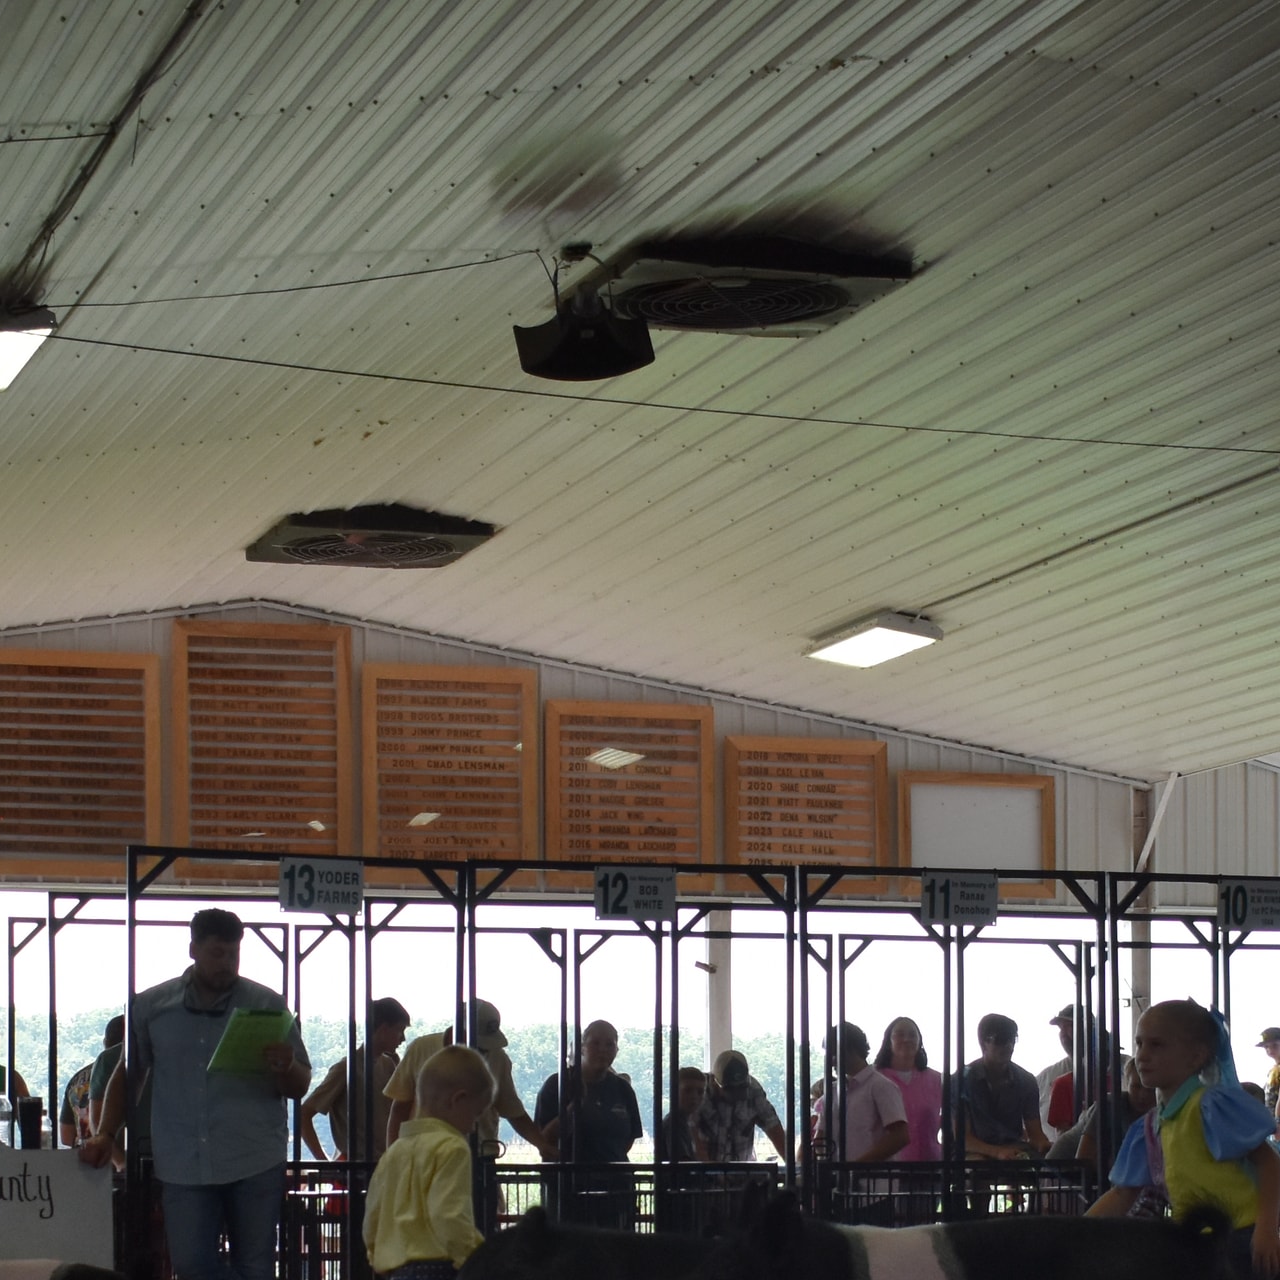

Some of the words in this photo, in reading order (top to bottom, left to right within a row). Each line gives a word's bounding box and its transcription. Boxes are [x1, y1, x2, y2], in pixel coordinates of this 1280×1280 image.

[411, 696, 448, 705] BLAZER
[455, 697, 488, 707] FARMS
[448, 713, 499, 723] BROTHERS
[411, 728, 441, 737] JIMMY
[447, 729, 482, 738] PRINCE
[227, 749, 265, 757] TAMARA
[273, 750, 312, 759] BLAZER
[417, 744, 445, 753] JIMMY
[450, 745, 485, 754] PRINCE
[569, 747, 591, 757] 2010
[427, 760, 453, 769] CHAD
[459, 761, 505, 771] LENSMAN
[568, 763, 587, 772] 2011
[568, 778, 590, 787] 2012
[747, 782, 772, 791] 2020
[780, 783, 799, 793] SHAE
[807, 784, 836, 794] CONRAD
[568, 794, 591, 803] 2013
[747, 797, 769, 806] 2021
[777, 798, 799, 807] WYATT
[806, 799, 844, 809] FAULKNER
[266, 812, 297, 820] CLARK
[568, 809, 591, 818] 2014
[599, 811, 618, 819] JACK
[747, 812, 772, 821] 2022
[780, 813, 799, 822] DENA
[807, 814, 835, 824] WILSON
[568, 824, 592, 833] 2015
[599, 826, 630, 834] MIRANDA
[747, 827, 772, 836] 2023
[782, 828, 803, 837] CALE
[813, 829, 834, 839] HALL
[423, 837, 448, 845] JOEY
[453, 838, 489, 846] BROWN
[568, 840, 591, 848] 2016
[599, 840, 629, 849] MIRANDA
[747, 843, 771, 851] 2024
[782, 844, 804, 854] CALE
[569, 855, 591, 863] 2017
[318, 870, 359, 885] YODER
[284, 863, 315, 908] 13
[639, 885, 658, 895] BOB
[960, 881, 986, 889] Memory
[317, 890, 359, 905] FARMS
[597, 872, 628, 914] 12
[960, 891, 985, 901] Ranae
[924, 878, 950, 919] 11
[633, 900, 663, 910] WHITE
[954, 905, 990, 915] Donohoe
[1220, 885, 1247, 926] 10
